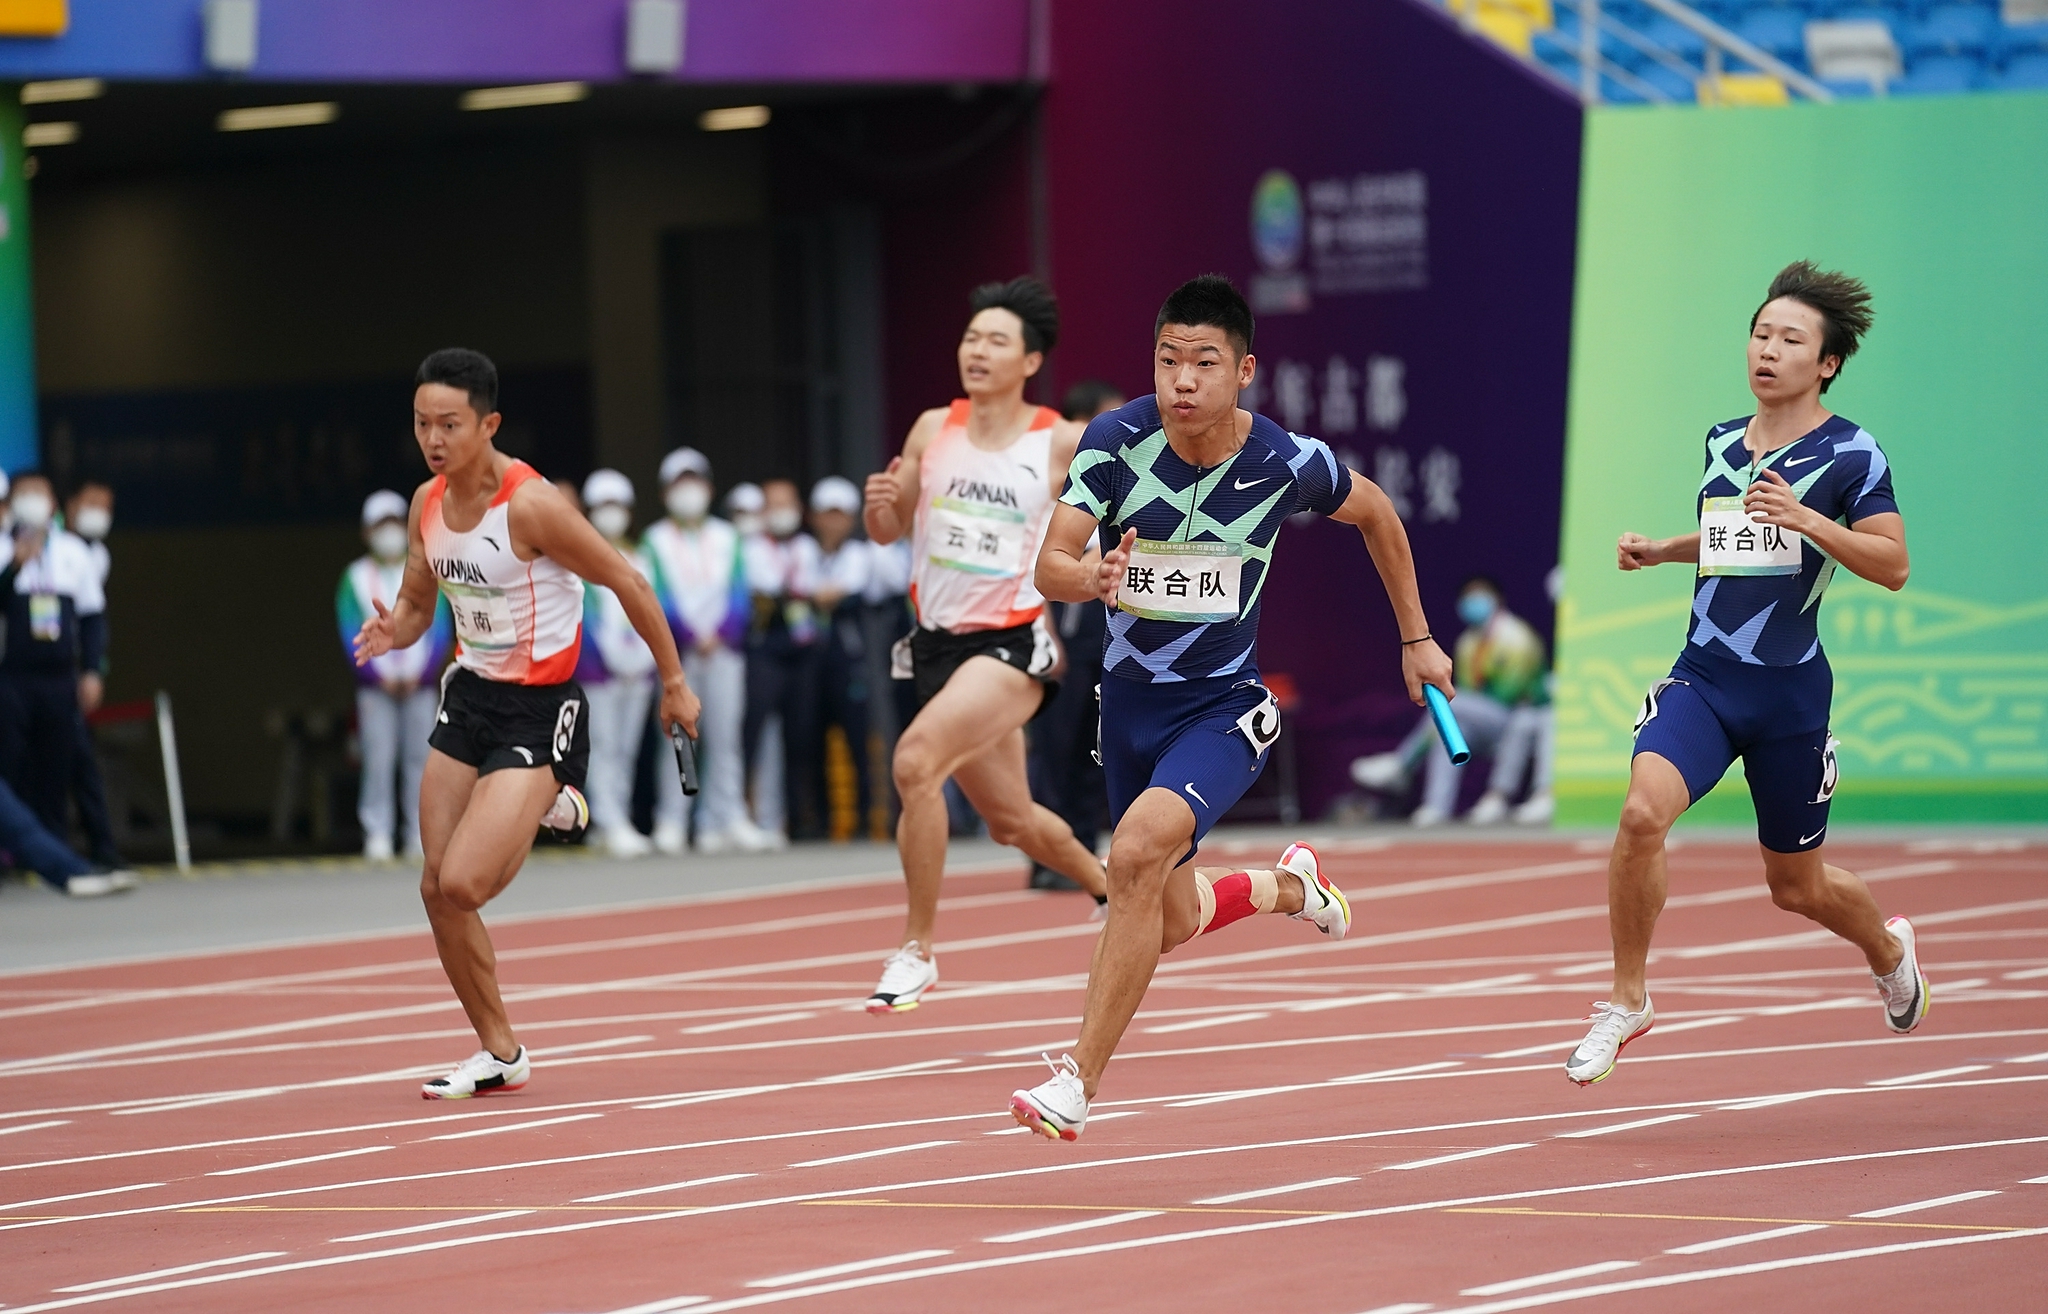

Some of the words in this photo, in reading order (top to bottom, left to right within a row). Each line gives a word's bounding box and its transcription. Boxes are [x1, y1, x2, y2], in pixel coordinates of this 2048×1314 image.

[944, 478, 1018, 508] YUNNAN
[947, 525, 999, 555] 云南
[1708, 525, 1788, 552] 联合队
[1126, 566, 1226, 598] 联合队
